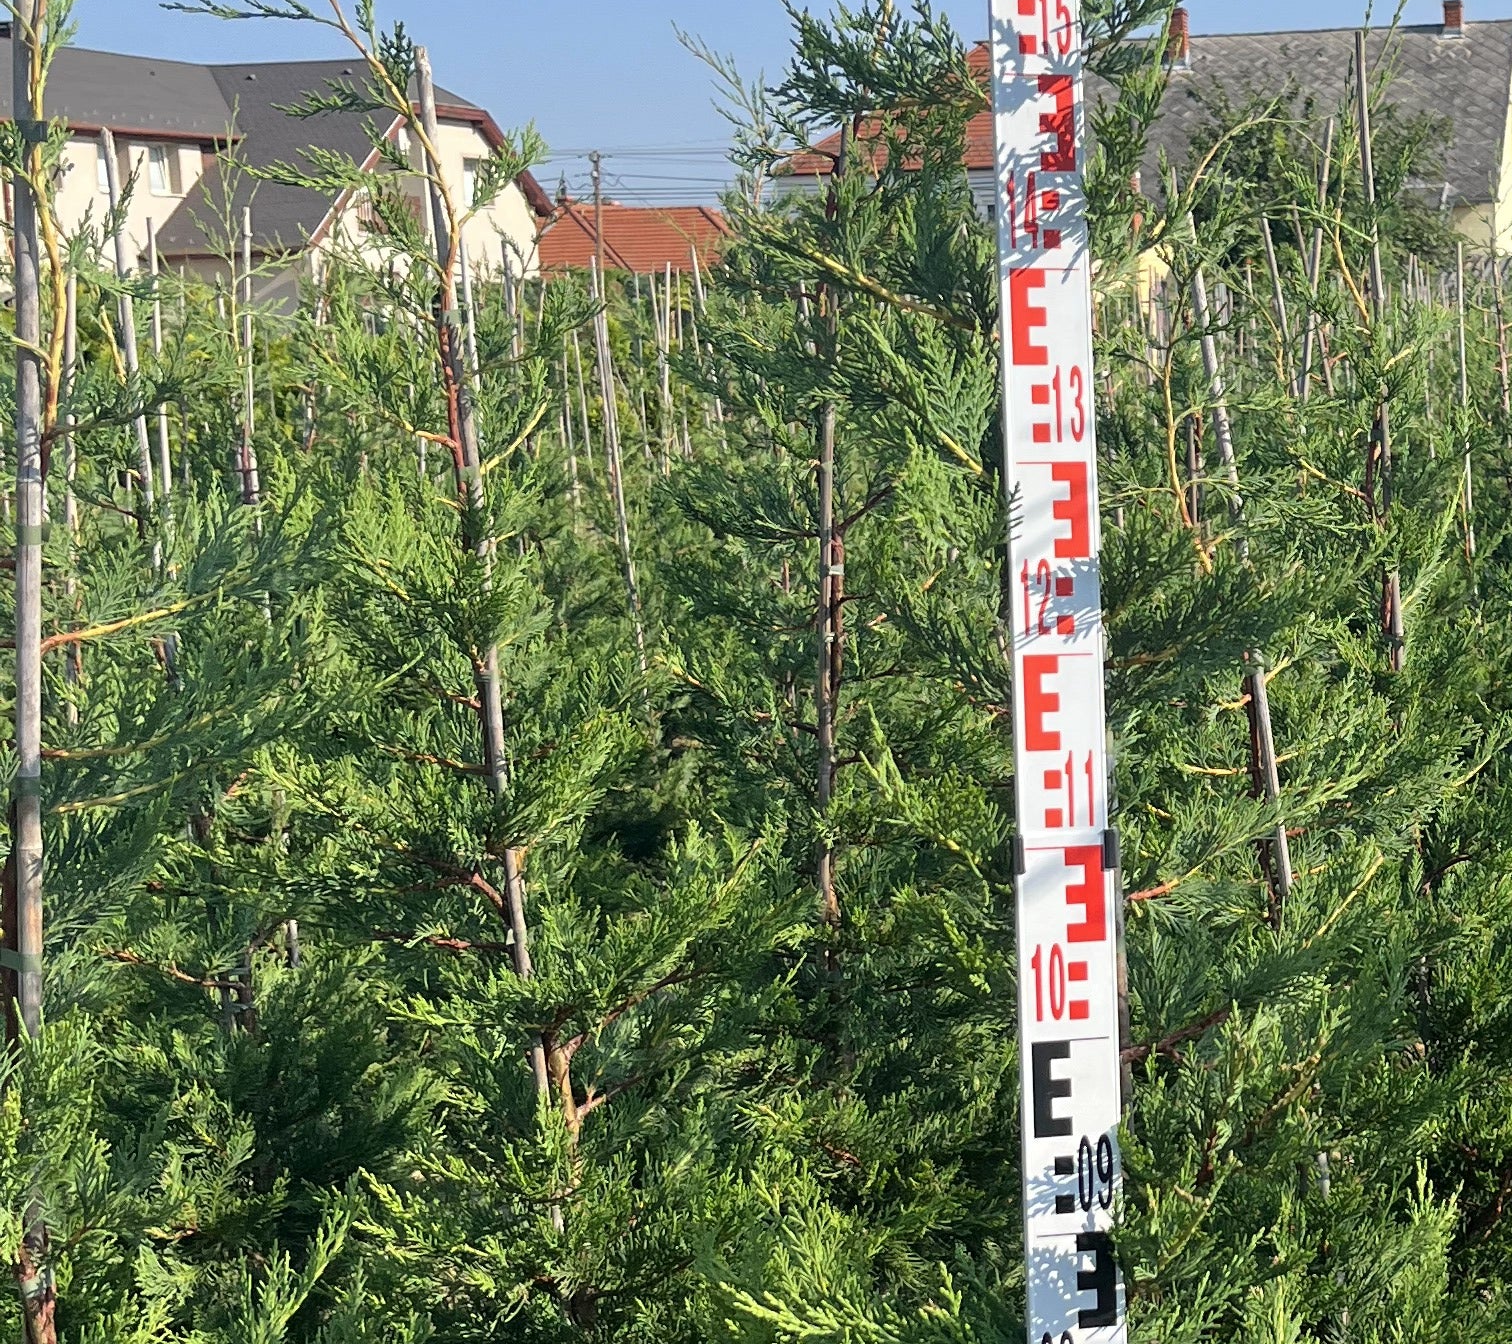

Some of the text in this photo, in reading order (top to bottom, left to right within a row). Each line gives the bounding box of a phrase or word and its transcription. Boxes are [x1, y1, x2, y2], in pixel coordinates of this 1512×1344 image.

[1006, 169, 1039, 249] 14
[1052, 364, 1085, 444] 13
[1020, 558, 1051, 637] 12
[1064, 749, 1094, 827] 11
[1031, 942, 1066, 1022] 10
[1078, 1133, 1114, 1212] 09
